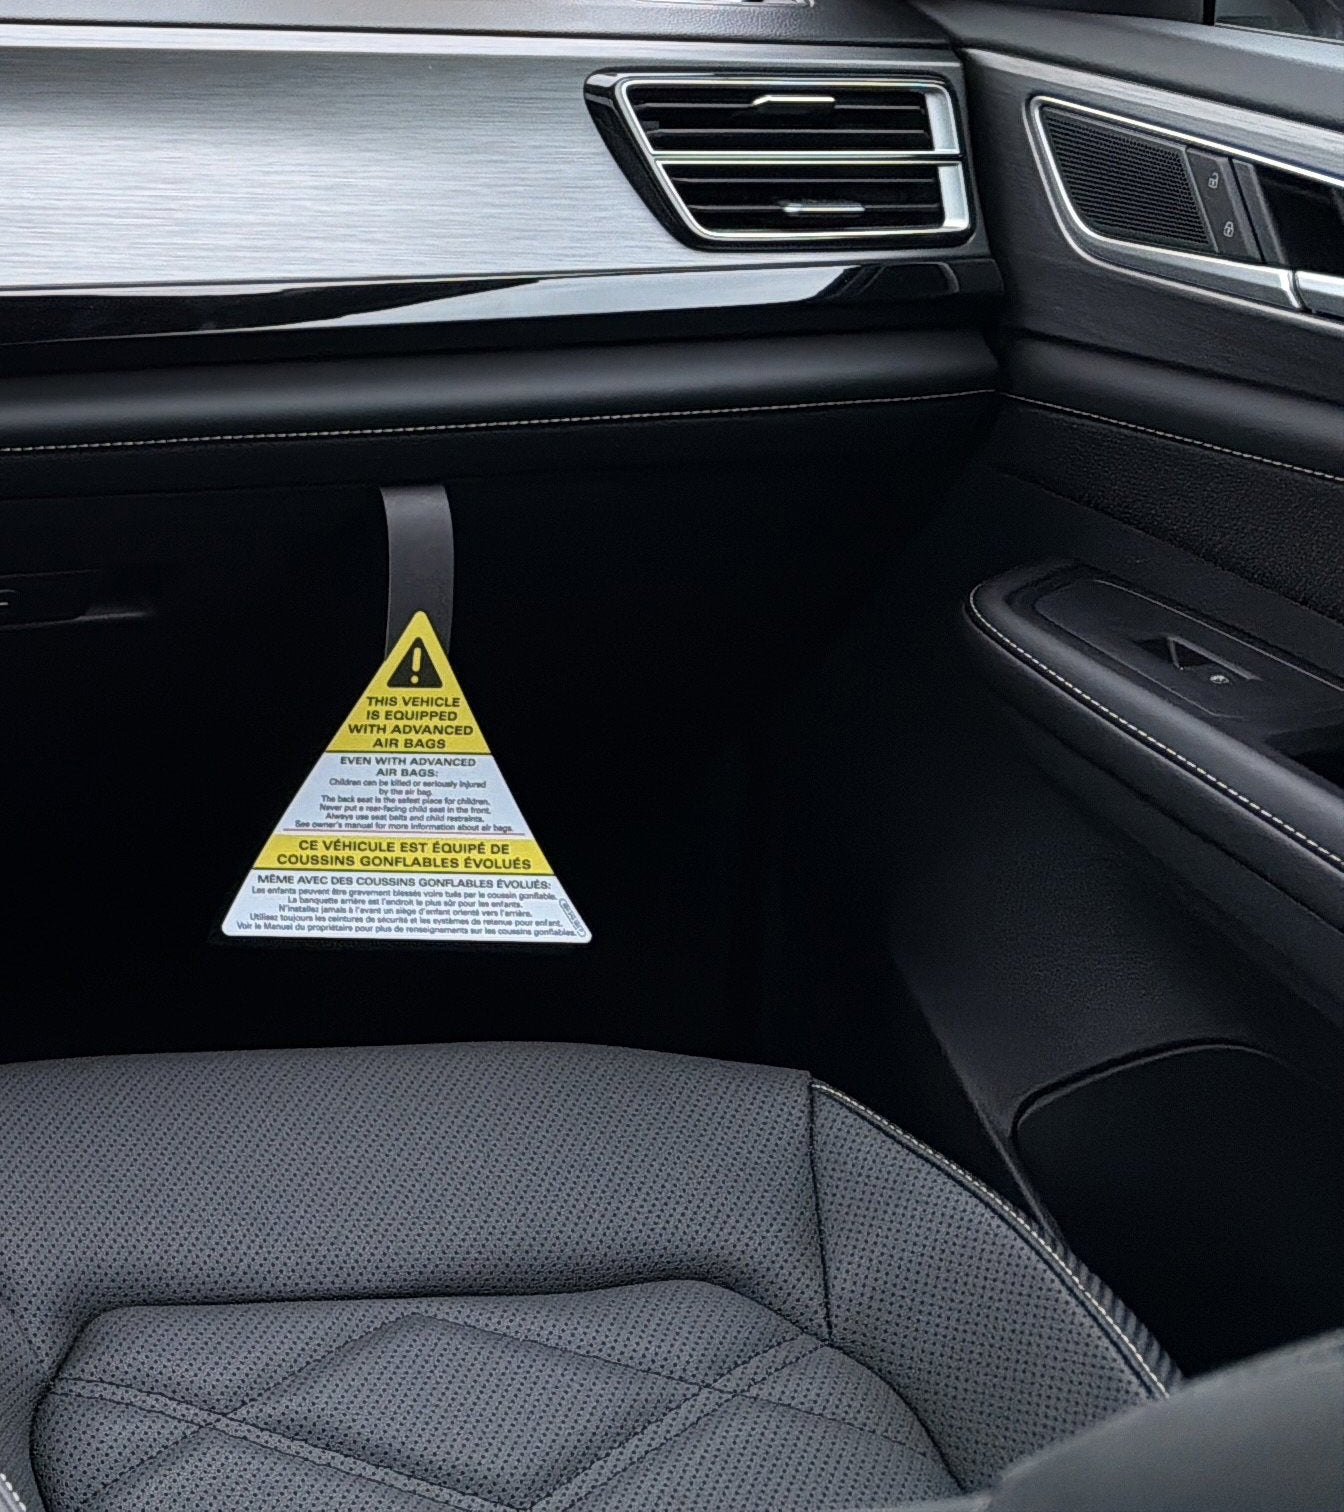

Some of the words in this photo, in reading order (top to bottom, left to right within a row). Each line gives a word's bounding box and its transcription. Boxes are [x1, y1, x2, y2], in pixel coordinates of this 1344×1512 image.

[366, 696, 398, 707] THIS
[402, 696, 461, 707] VEHICLE
[366, 710, 380, 720] IS
[384, 710, 458, 721] EQUIPPED
[348, 724, 387, 734] WITH
[390, 724, 474, 735] ADVANCED
[373, 738, 399, 748] AIR
[404, 738, 446, 749] BAGS
[340, 757, 372, 766] EVEN
[374, 757, 407, 766] WITH
[409, 757, 476, 767] ADVANCED
[376, 768, 397, 777] AIR
[401, 768, 439, 778] BAGS:
[329, 778, 362, 787] Children
[378, 779, 389, 787] be
[390, 779, 411, 787] killed
[422, 780, 457, 789] seriously
[459, 780, 486, 790] injured
[378, 788, 389, 797] by
[390, 788, 403, 796] the
[404, 788, 415, 796] air
[299, 840, 319, 851] CE
[322, 838, 396, 852] VÉHICULE
[400, 841, 428, 853] EST
[432, 839, 486, 854] ÉQUIPÉ
[490, 843, 510, 854] DE
[276, 854, 354, 866] COUSSINS
[360, 855, 459, 868] GONFLABLES
[464, 854, 532, 870] ÉVOLUÉS
[257, 874, 295, 884] MÊME
[297, 876, 329, 885] AVEC
[331, 877, 354, 885] DES
[356, 877, 416, 887] COUSSINS
[418, 878, 494, 889] GONFLABLES
[496, 878, 551, 889] ÉVOLUÉS:
